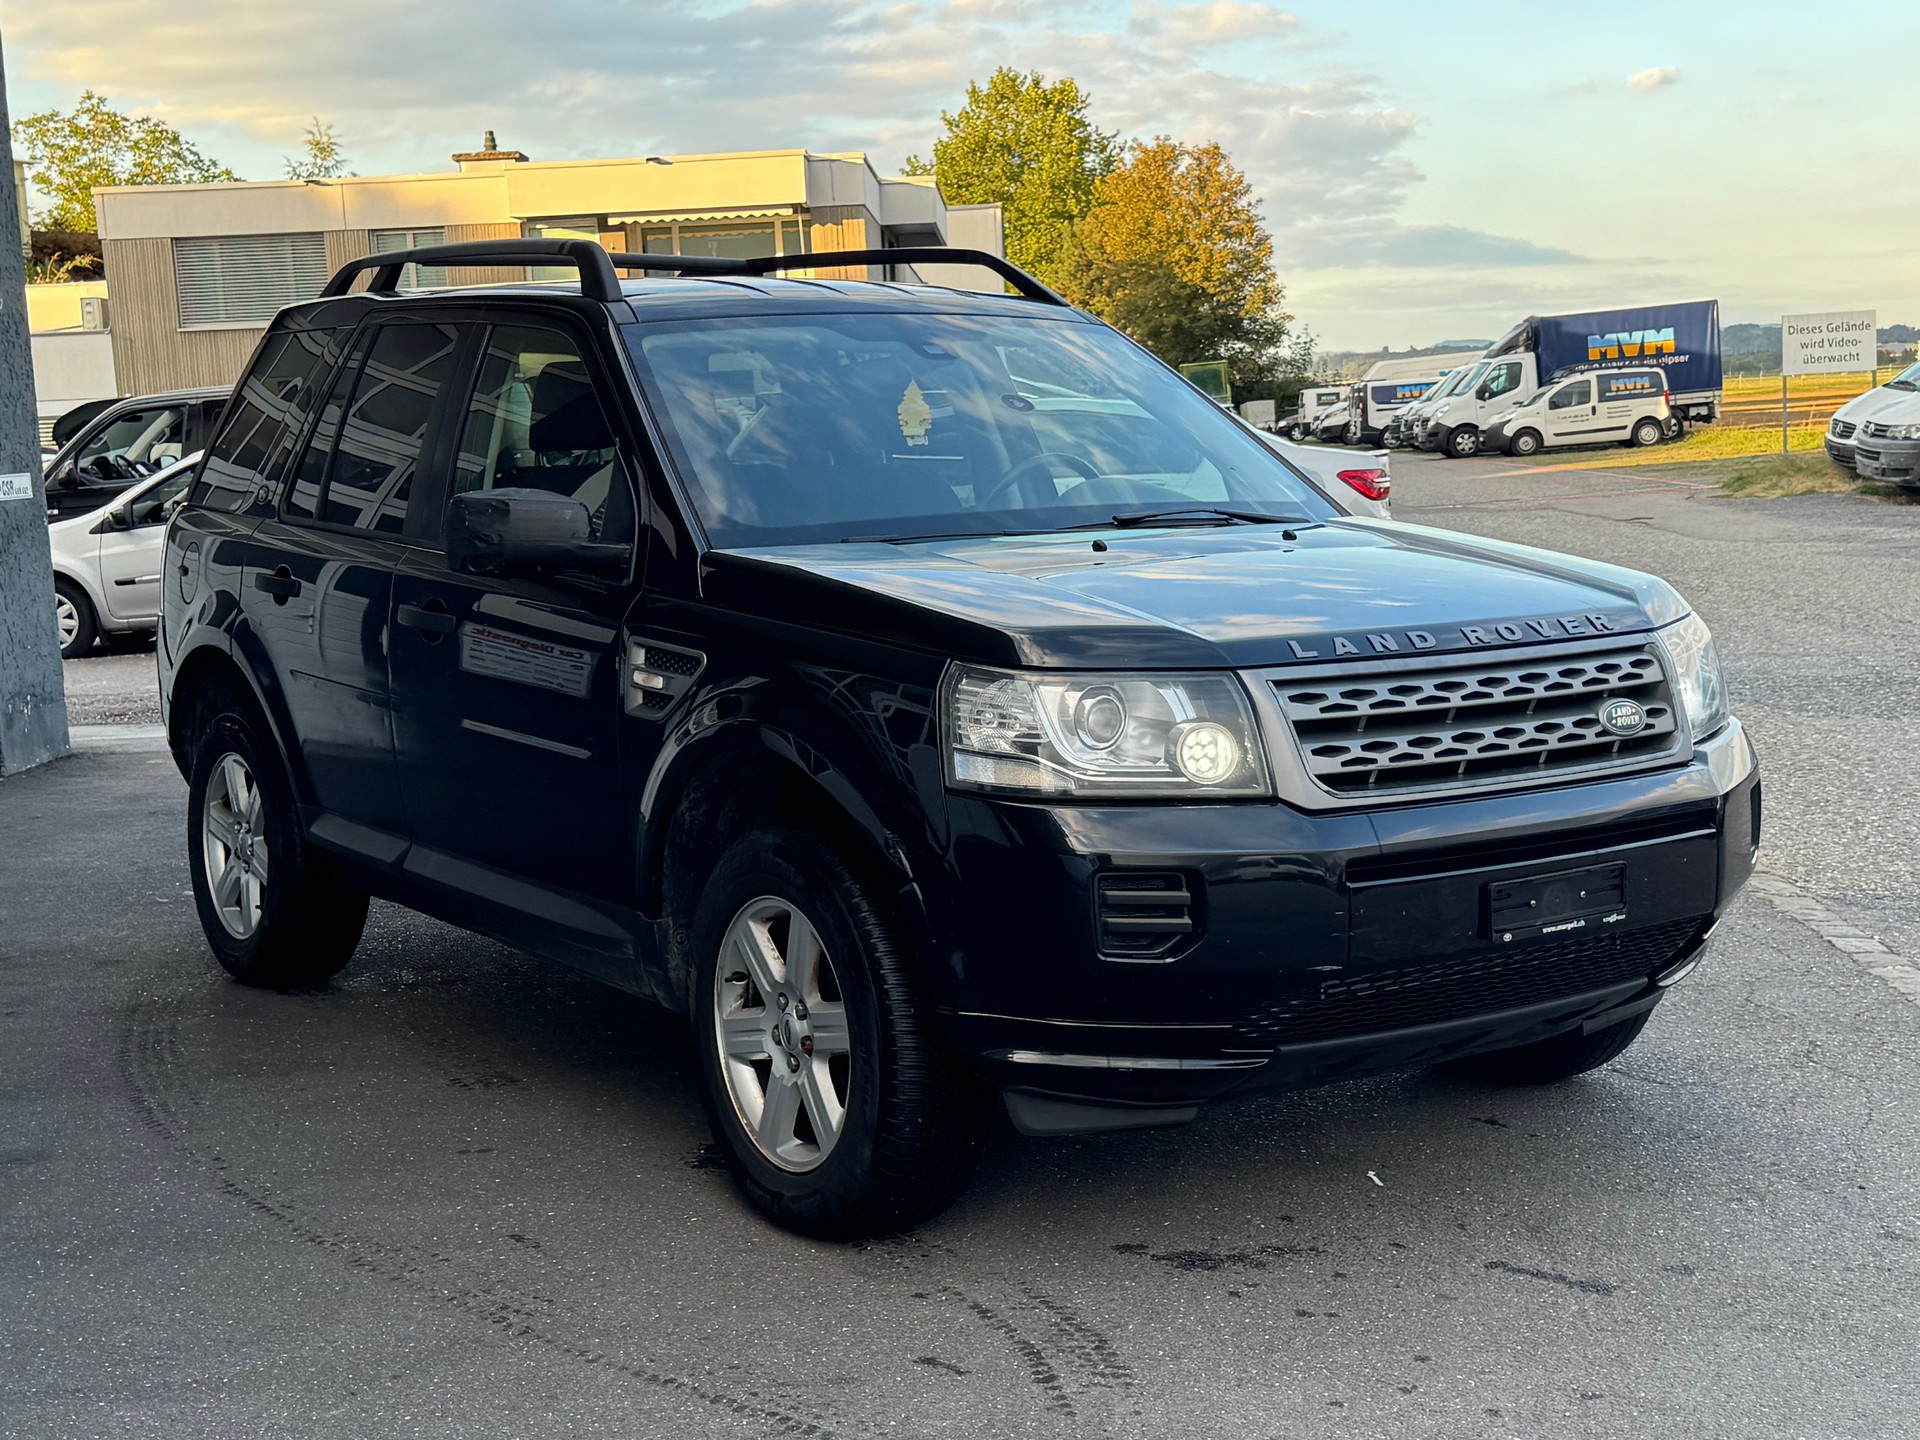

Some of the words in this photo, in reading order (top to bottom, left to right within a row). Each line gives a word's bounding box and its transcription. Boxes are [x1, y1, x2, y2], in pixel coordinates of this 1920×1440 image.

[1788, 324, 1823, 335] Dieses
[1826, 320, 1871, 333] Gelände
[1587, 327, 1675, 360] MVM
[1800, 338, 1824, 349] wird
[1827, 337, 1862, 347] Video-
[1803, 352, 1860, 364] überwacht
[1610, 376, 1650, 391] MVM
[1287, 631, 1437, 659] LAND
[1459, 614, 1616, 645] ROVER
[1611, 706, 1632, 718] LAND
[1616, 714, 1640, 727] ROVER
